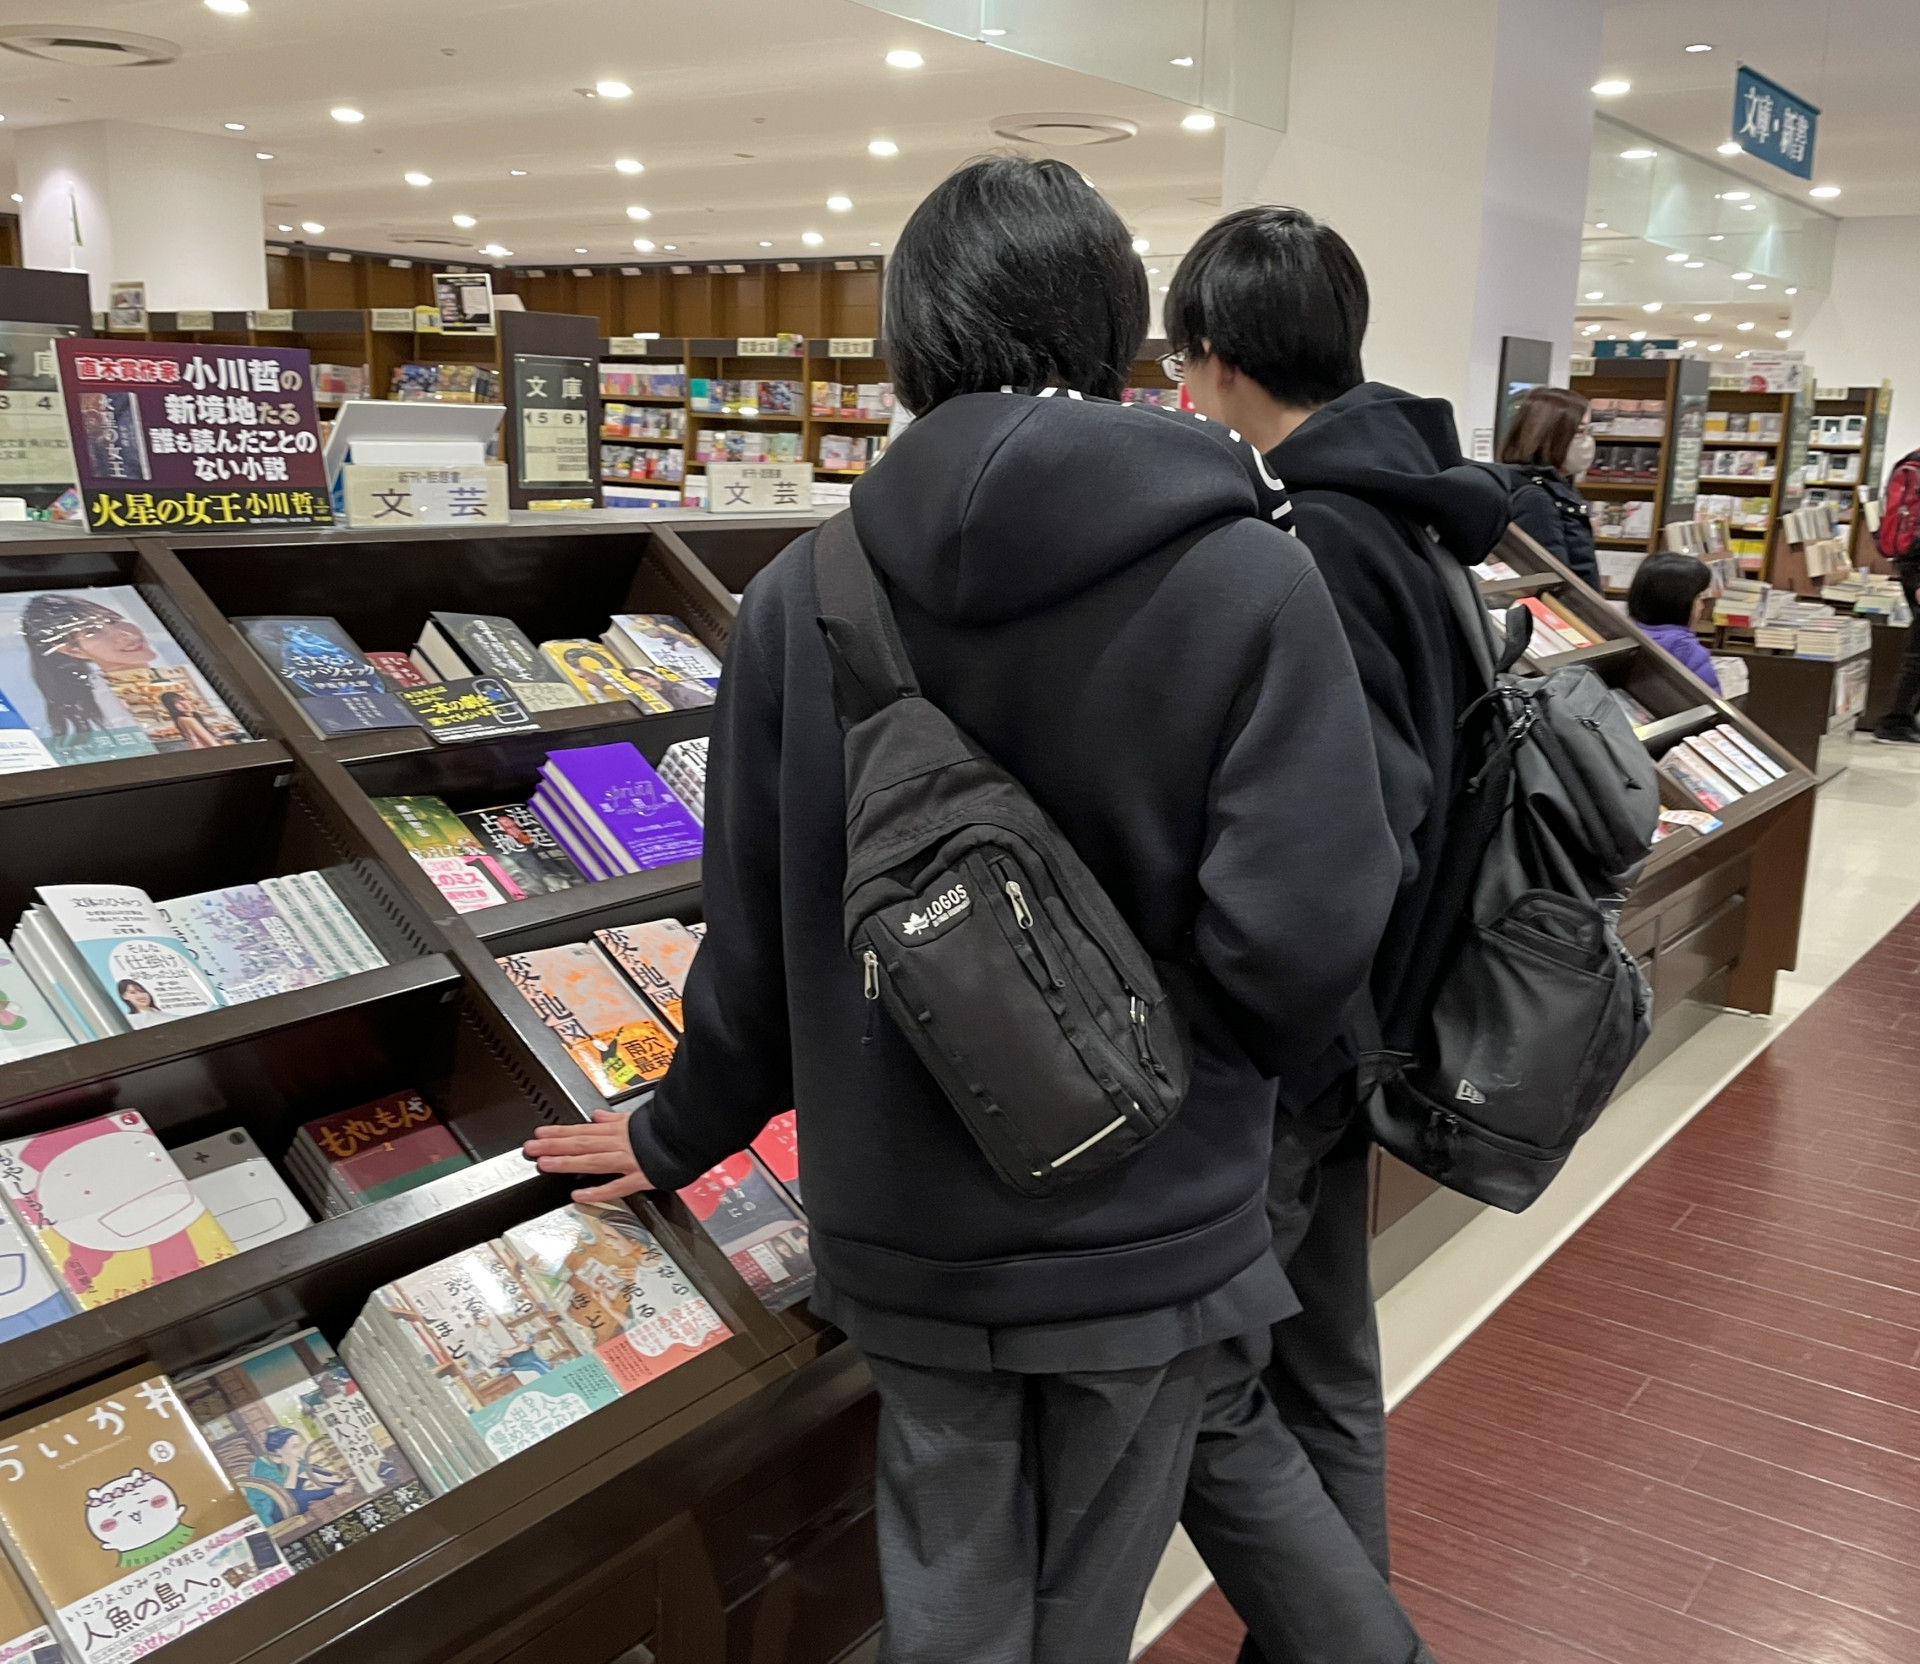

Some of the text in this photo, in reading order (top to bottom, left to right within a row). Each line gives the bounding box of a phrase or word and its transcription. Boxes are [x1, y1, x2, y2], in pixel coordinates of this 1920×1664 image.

[1740, 87, 1808, 161] 文庫・新書
[74, 356, 303, 392] 直木賞作家 小川哲の
[525, 376, 583, 399] 文庫
[36, 396, 52, 410] 4
[164, 394, 301, 425] 新境地たる
[537, 413, 573, 424] 5 6
[150, 428, 317, 454] 誰も読んだことの
[193, 457, 289, 481] ない小説
[371, 487, 488, 518] 文芸
[724, 481, 797, 506] 文芸
[92, 492, 314, 527] 火星の女王 小川哲
[280, 664, 375, 679] ジャバウォック
[926, 884, 967, 920] LOGOS
[154, 1444, 170, 1460] 8
[83, 1577, 221, 1651] 人魚の島へ。
